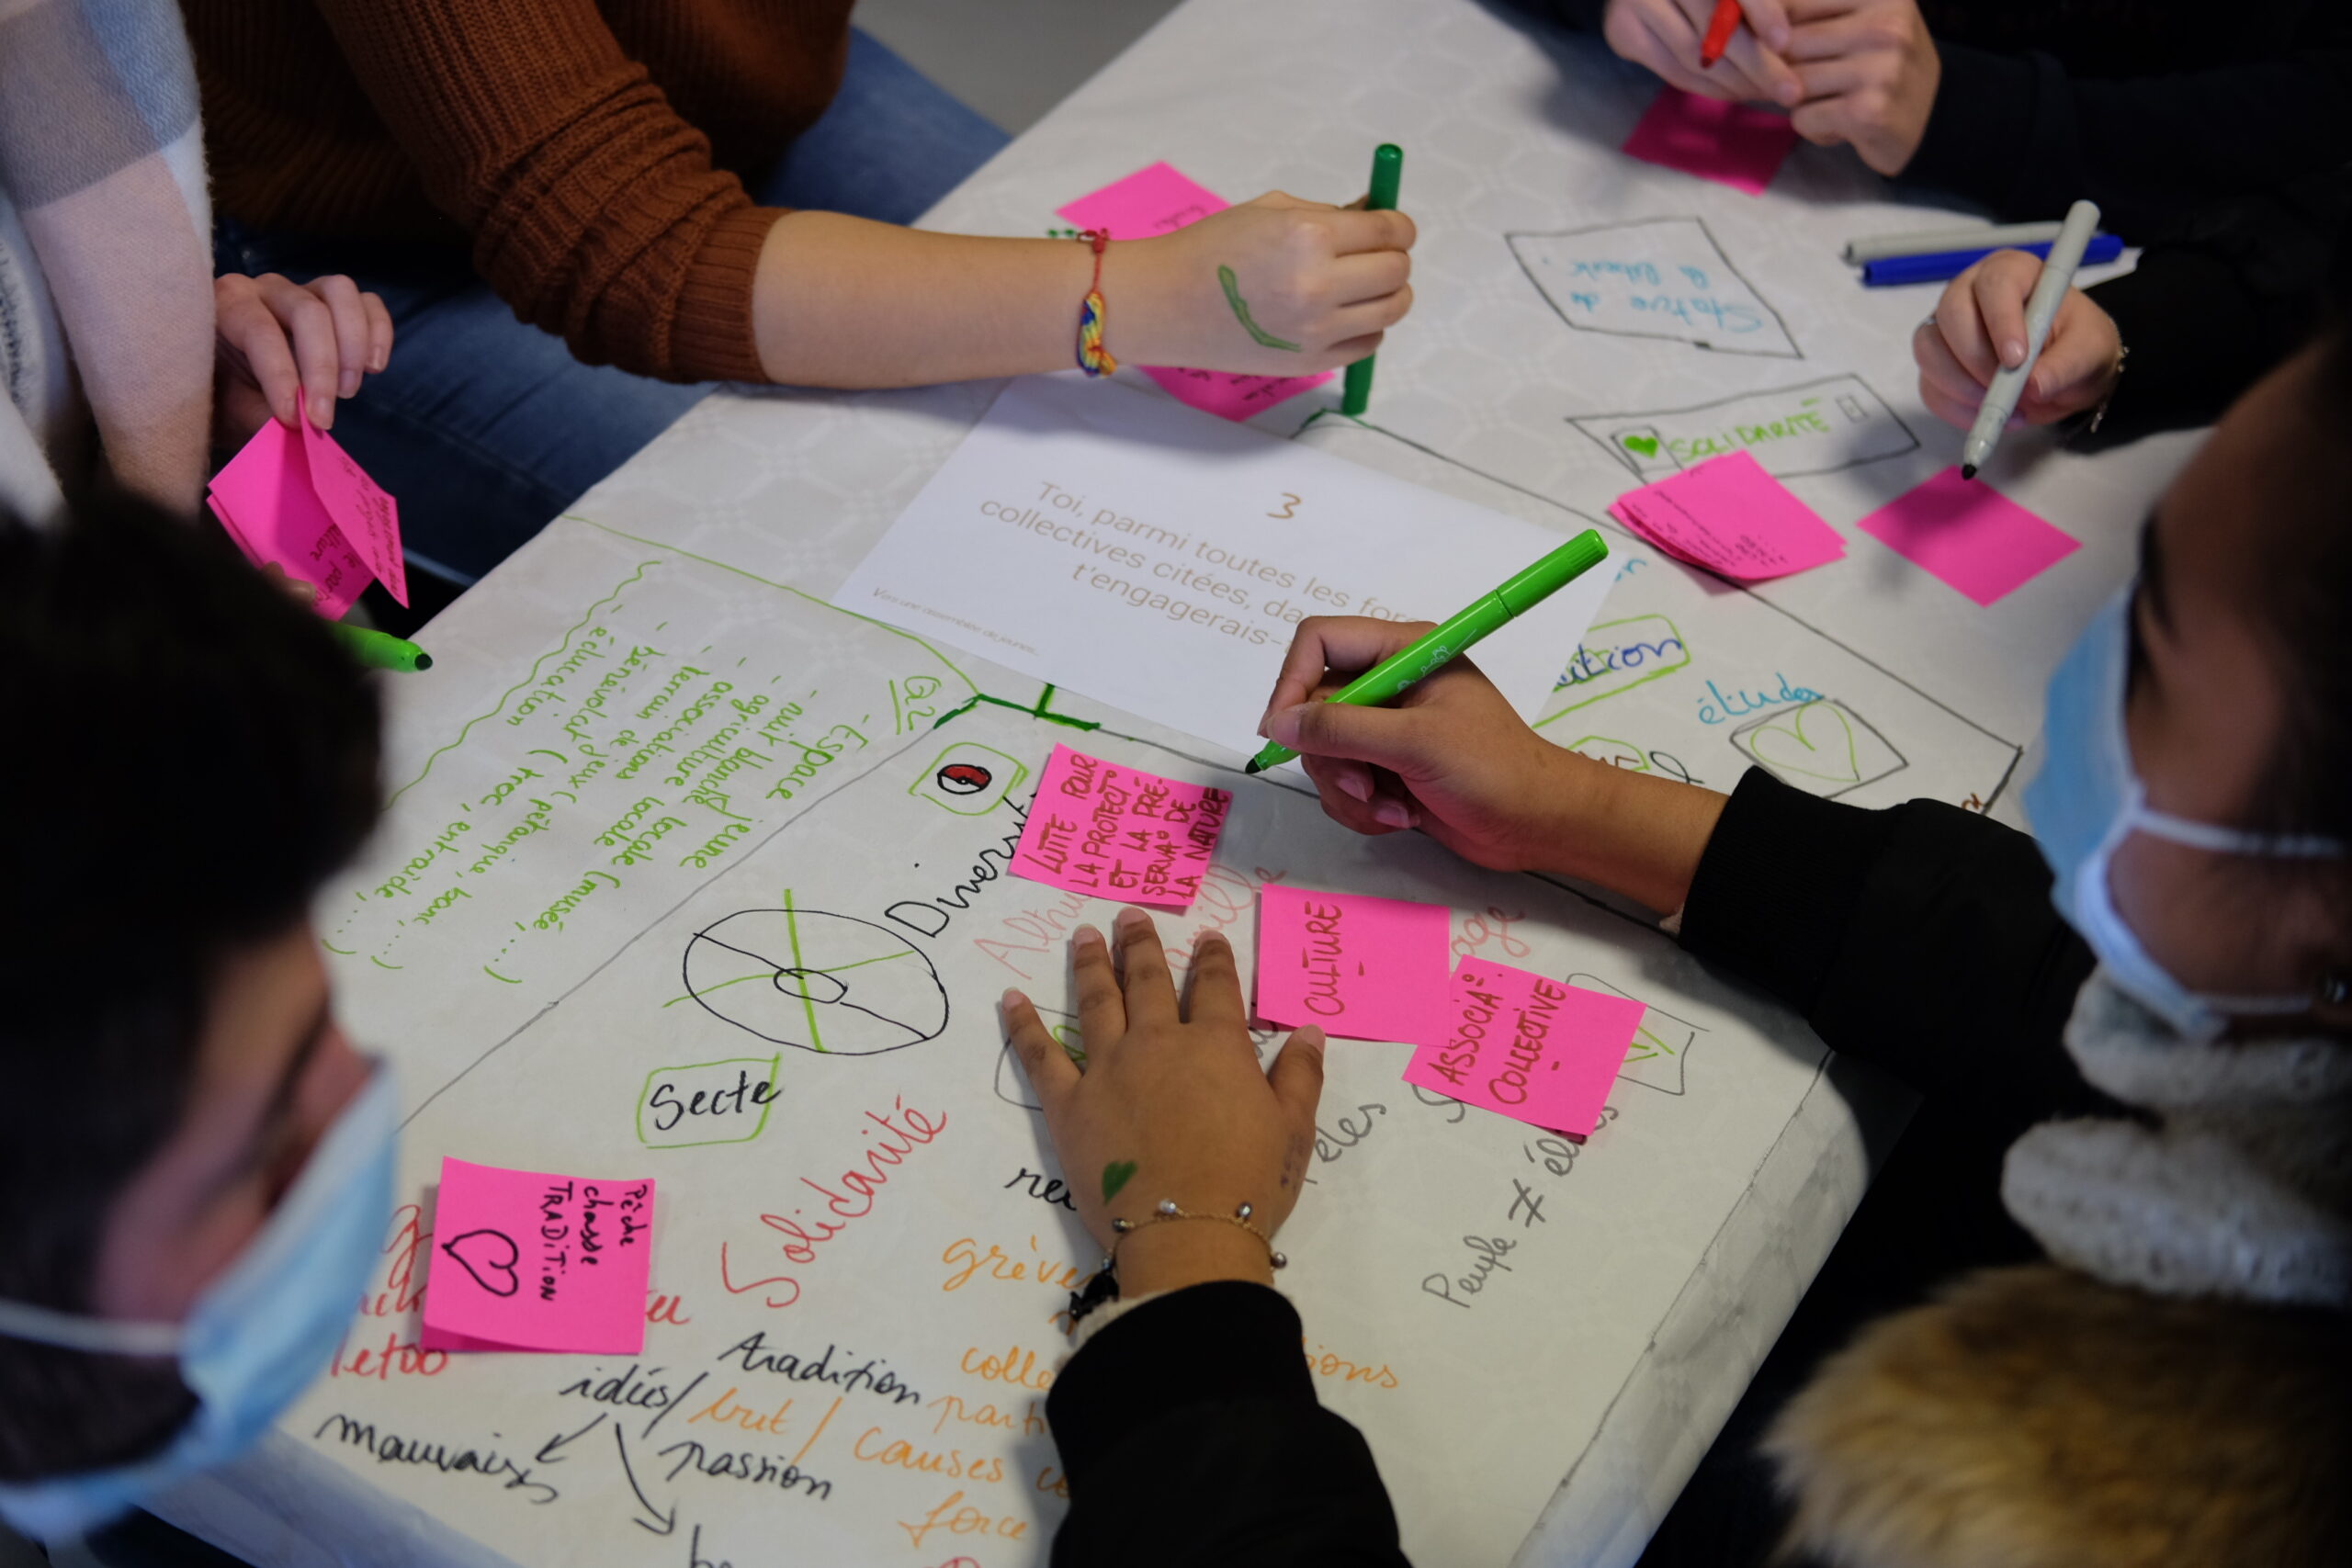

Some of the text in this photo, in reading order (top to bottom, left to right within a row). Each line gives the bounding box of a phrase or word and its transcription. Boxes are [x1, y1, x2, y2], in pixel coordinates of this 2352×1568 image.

[1265, 492, 1303, 520] 3
[979, 497, 1145, 569] collectives
[1152, 556, 1256, 614] citées,
[1038, 480, 1418, 623] Toi, parmi toutes les for
[1071, 560, 1291, 654] t'engagerais-
[1023, 753, 1099, 874] LUTTE POUR
[1119, 829, 1152, 857] LA
[1164, 798, 1197, 826] DE
[1169, 787, 1232, 900] LA NATURE
[1069, 860, 1105, 888] LA
[1109, 858, 1138, 891] ET
[1303, 901, 1345, 1016] CULTURE
[1451, 907, 1533, 958] age
[649, 1069, 782, 1132] Secte
